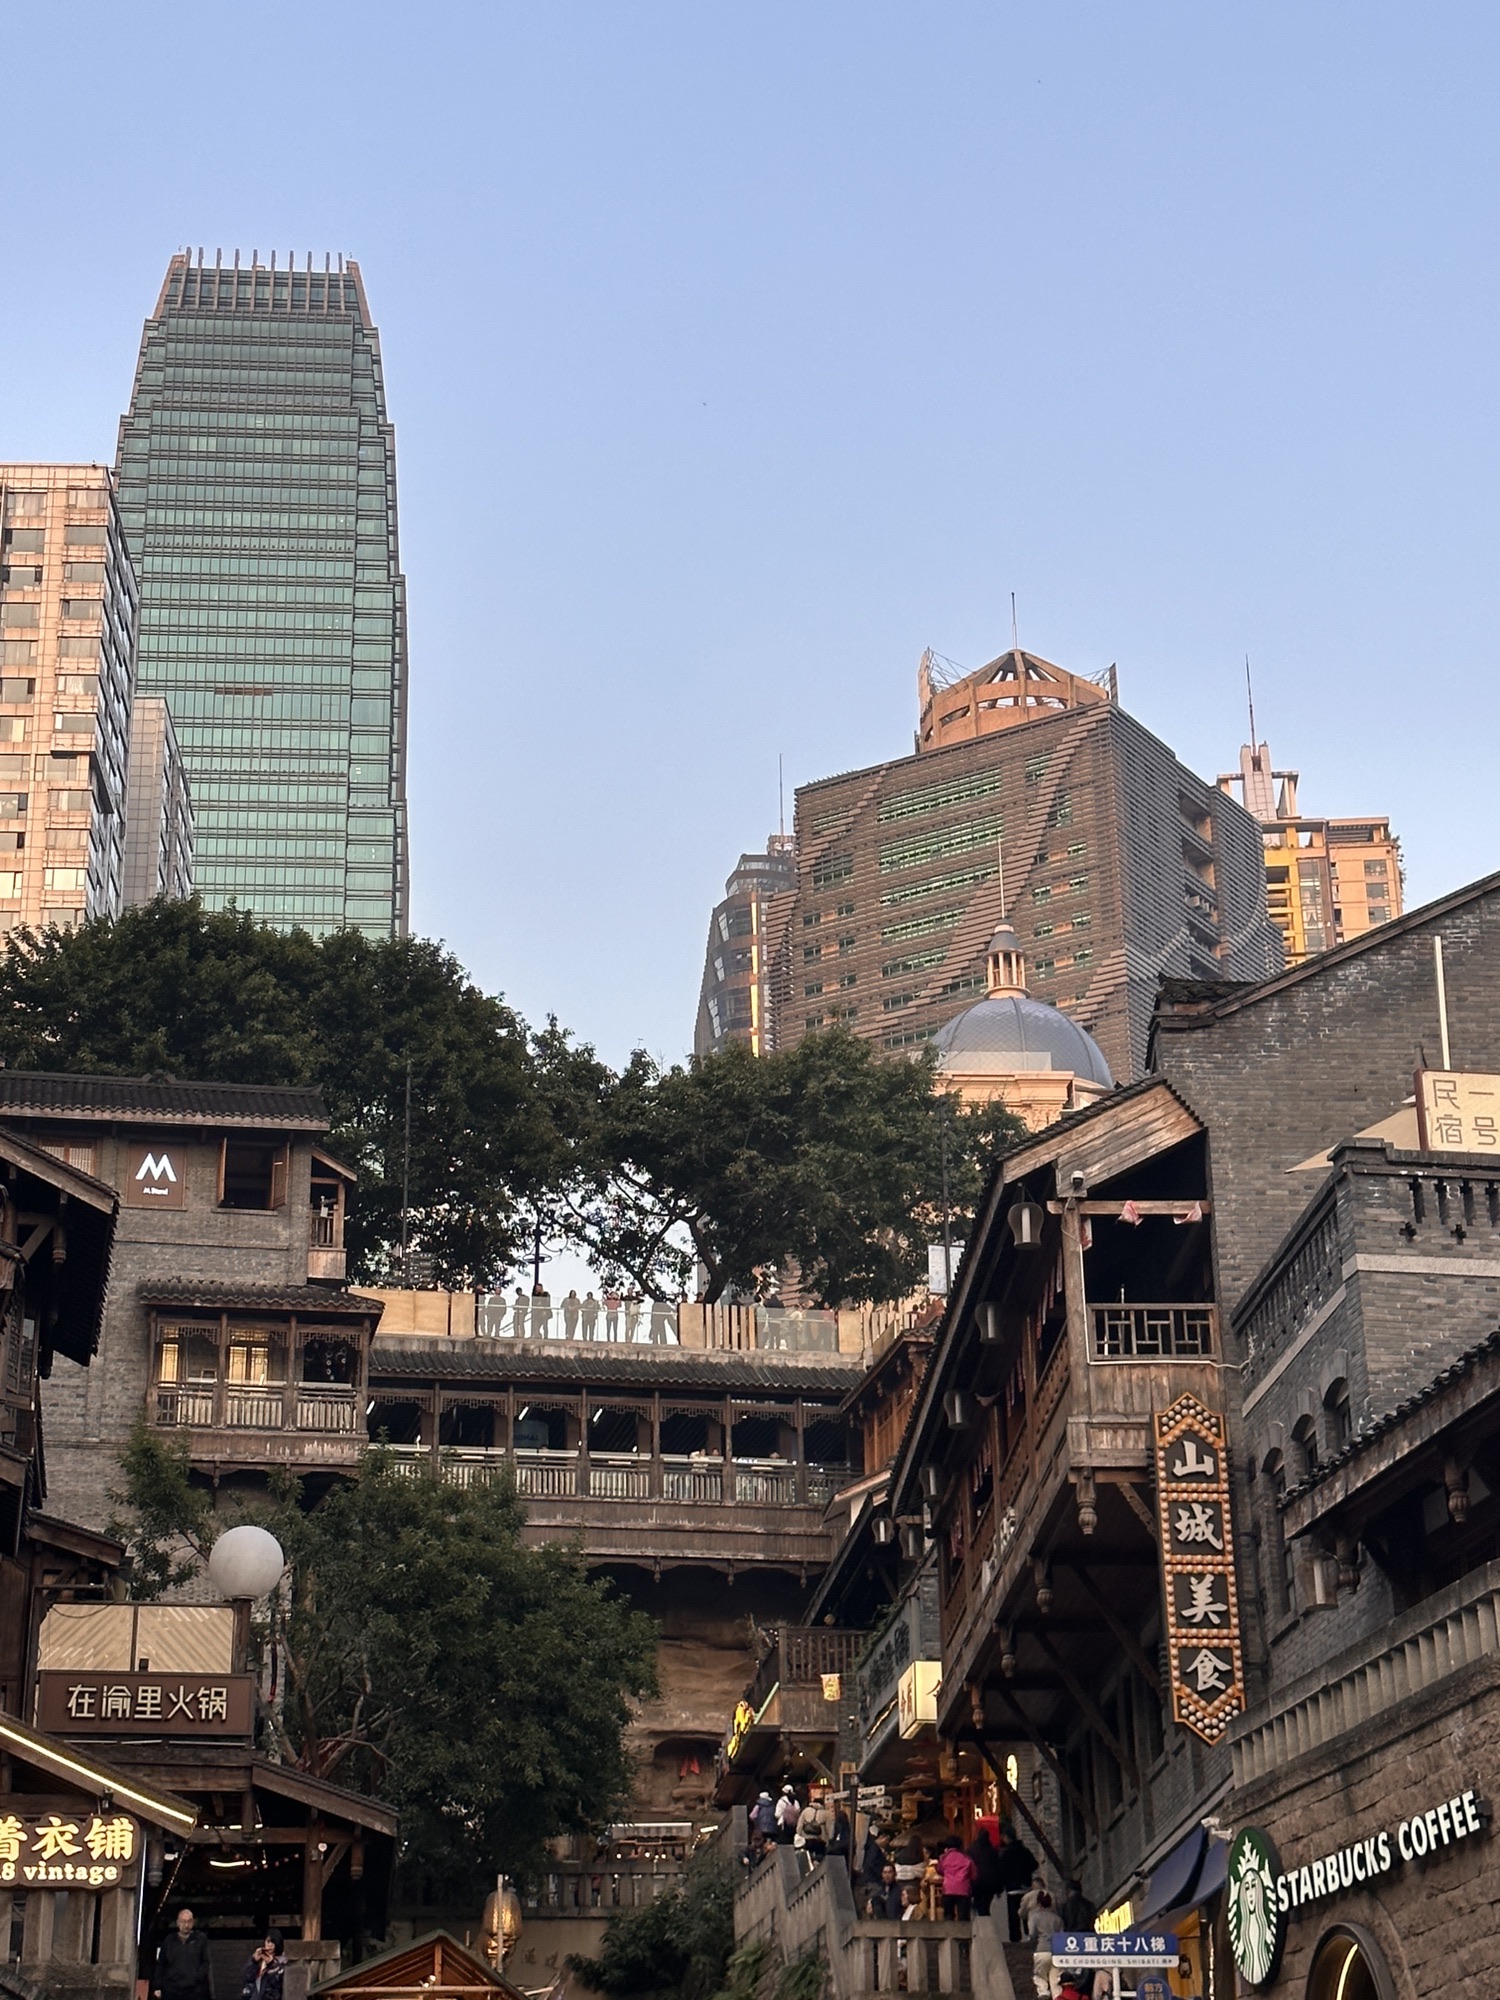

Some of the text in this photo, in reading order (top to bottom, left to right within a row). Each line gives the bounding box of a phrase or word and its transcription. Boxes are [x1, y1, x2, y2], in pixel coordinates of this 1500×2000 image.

[1432, 1079, 1462, 1145] 民宿
[1173, 1441, 1232, 1692] 山城美食
[67, 1684, 227, 1720] 在渝里火锅
[0, 1861, 118, 1885] 8 vintage
[1277, 1790, 1480, 1912] STARBUCKS COFFEE
[1084, 1936, 1166, 1952] 重庆十八梯
